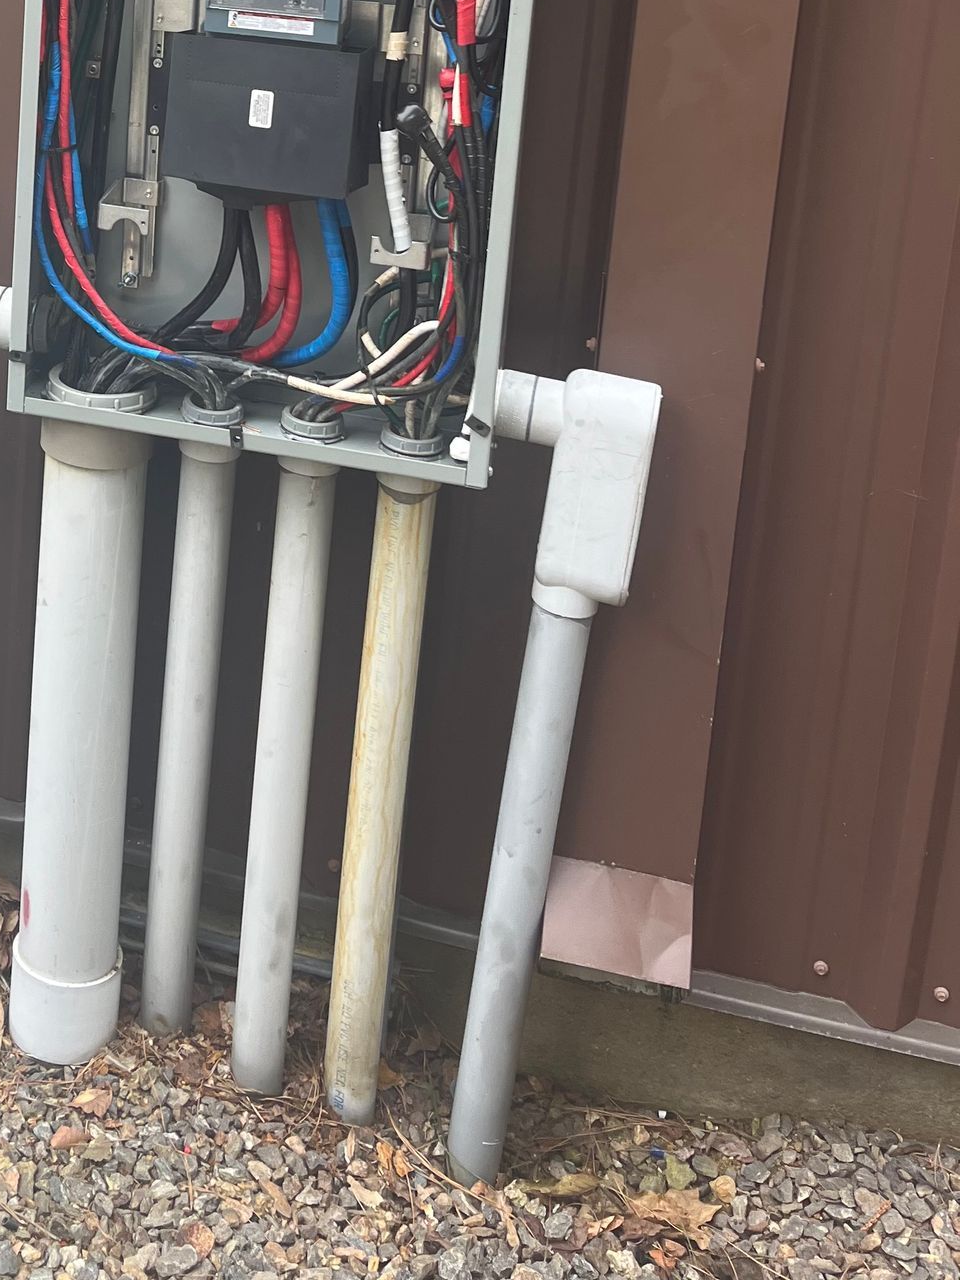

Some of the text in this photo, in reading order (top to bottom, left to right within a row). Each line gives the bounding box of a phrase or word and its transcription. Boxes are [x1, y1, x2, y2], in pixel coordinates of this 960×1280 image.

[339, 1021, 352, 1041] PVC
[337, 1044, 350, 1063] USE
[333, 1089, 346, 1110] FOR
